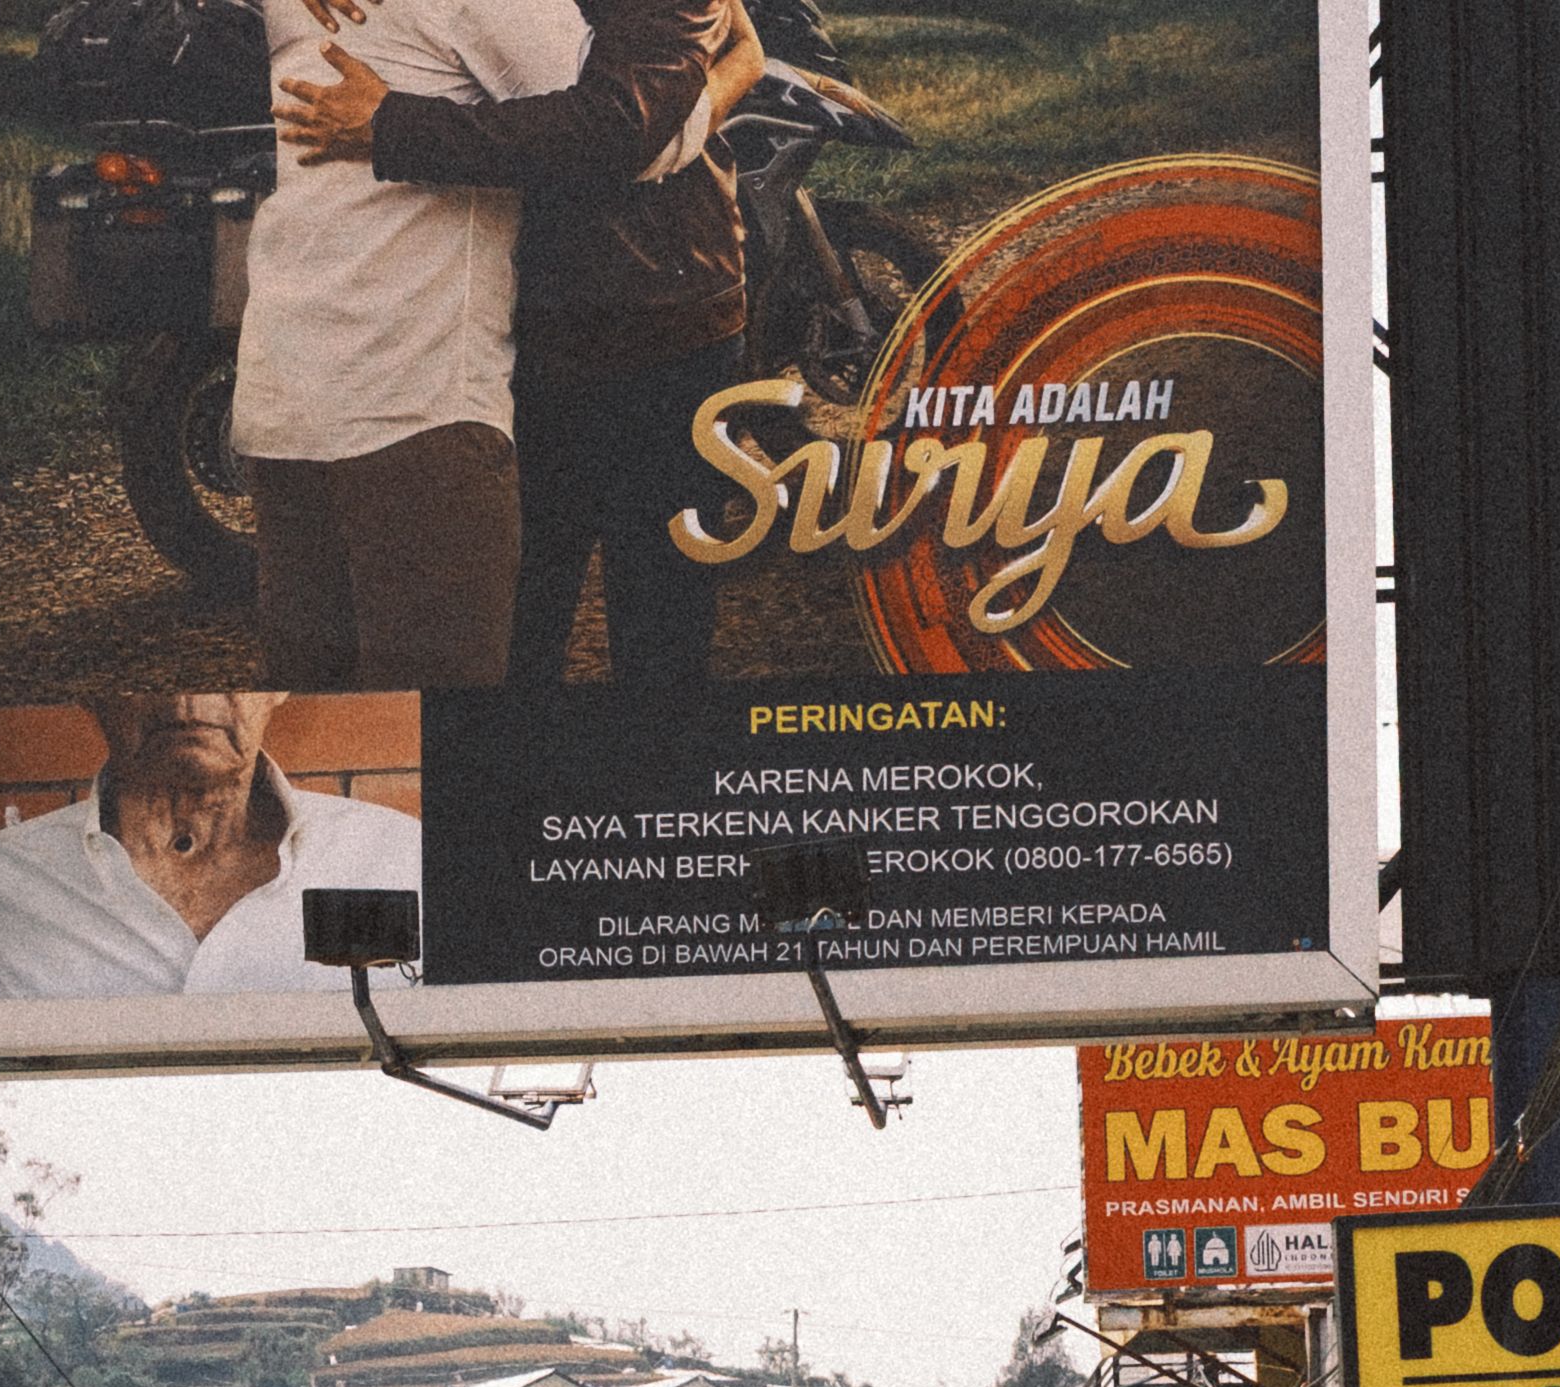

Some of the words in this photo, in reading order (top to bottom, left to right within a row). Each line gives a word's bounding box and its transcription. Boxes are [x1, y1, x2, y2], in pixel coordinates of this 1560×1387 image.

[905, 385, 994, 428] KITA
[1010, 379, 1175, 424] ADALAH
[668, 379, 1289, 633] Surya
[749, 699, 1007, 735] PERINGATAN:
[714, 768, 854, 796] KARENA
[862, 763, 1043, 792] MEROKOK,
[542, 815, 627, 841] SAYA
[634, 810, 794, 839] TERKENA
[802, 805, 940, 834] KANKER
[950, 799, 1219, 831] TENGGOROKAN
[530, 856, 665, 882] LAYANAN
[866, 847, 995, 874] EROKOK
[1003, 842, 1233, 875] (0800-177-6565)
[598, 914, 731, 937] DILARANG
[868, 908, 922, 929] DAN
[931, 905, 1052, 927] MEMBERI
[1061, 902, 1167, 925] KEPADA
[538, 946, 633, 967] ORANG
[642, 944, 666, 965] DI
[675, 942, 768, 964] BAWAH
[775, 941, 802, 961] 21
[818, 938, 899, 961] TAHUN
[908, 936, 963, 957] DAN
[971, 933, 1138, 957] PEREMPUAN
[1145, 931, 1226, 952] HAMIL
[1103, 1038, 1226, 1082] Bebek
[1267, 1036, 1390, 1092] Ayam
[1398, 1023, 1493, 1085] Kam
[1104, 1104, 1328, 1183] MAS
[1105, 1196, 1265, 1218] PRASMANAN,
[1272, 1190, 1346, 1211] AMBIL
[1354, 1188, 1449, 1208] SENDIRI
